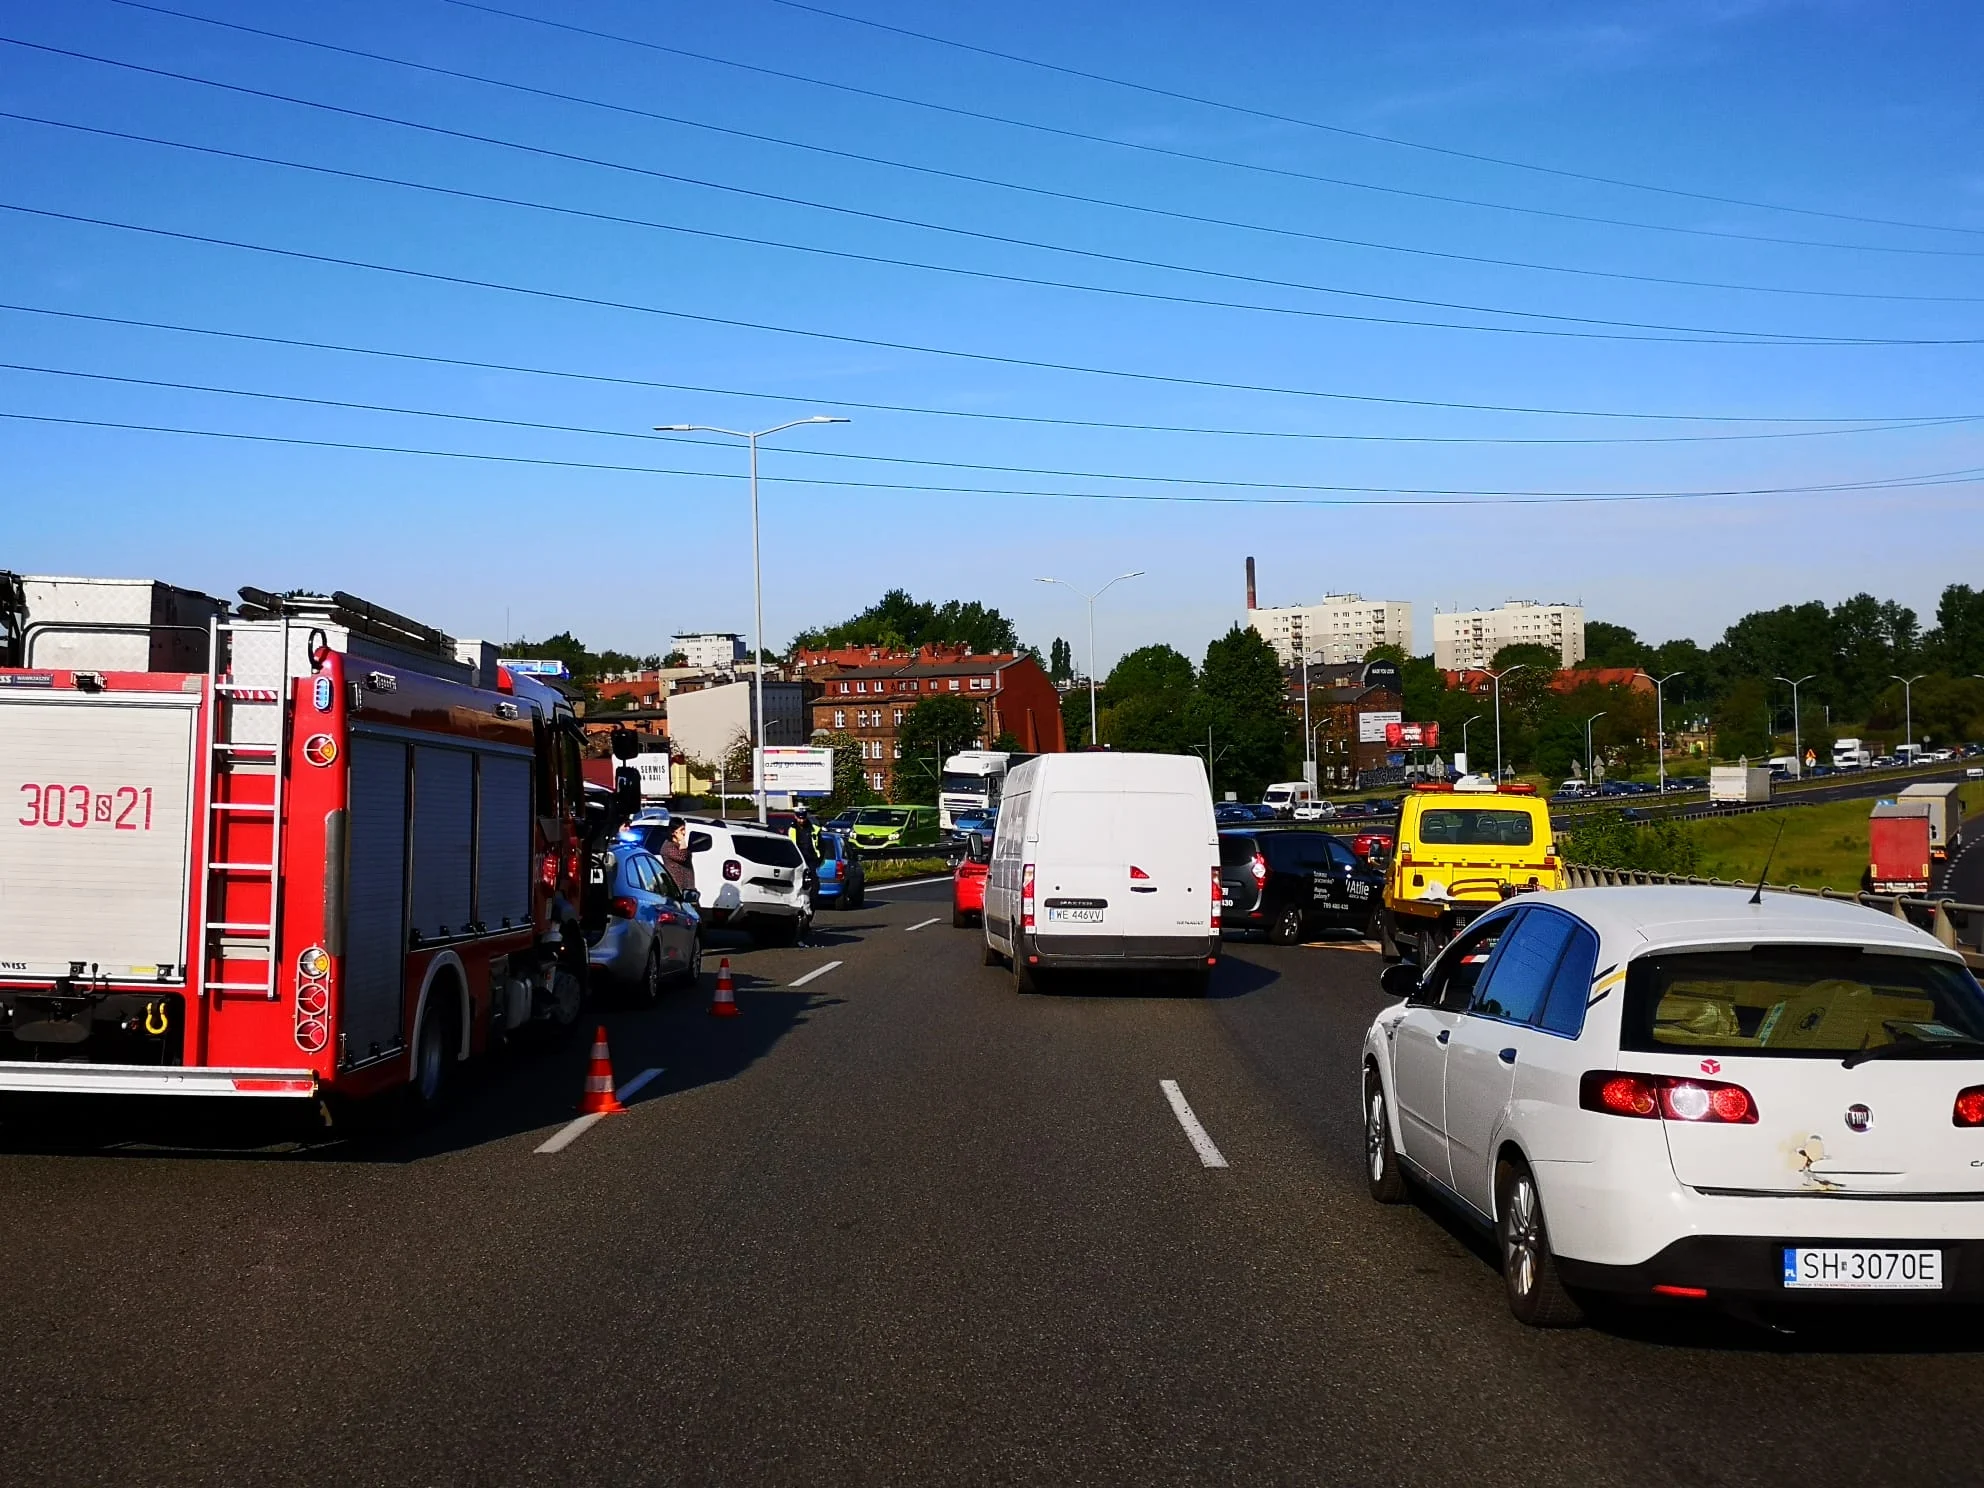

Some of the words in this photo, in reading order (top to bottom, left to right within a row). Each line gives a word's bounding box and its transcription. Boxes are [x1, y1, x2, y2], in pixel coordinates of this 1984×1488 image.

[640, 765, 666, 774] SERWIS
[1056, 910, 1069, 920] WE
[1803, 1252, 1838, 1279] SH
[1852, 1253, 1934, 1280] 3070E
[1785, 1268, 1796, 1277] PL
